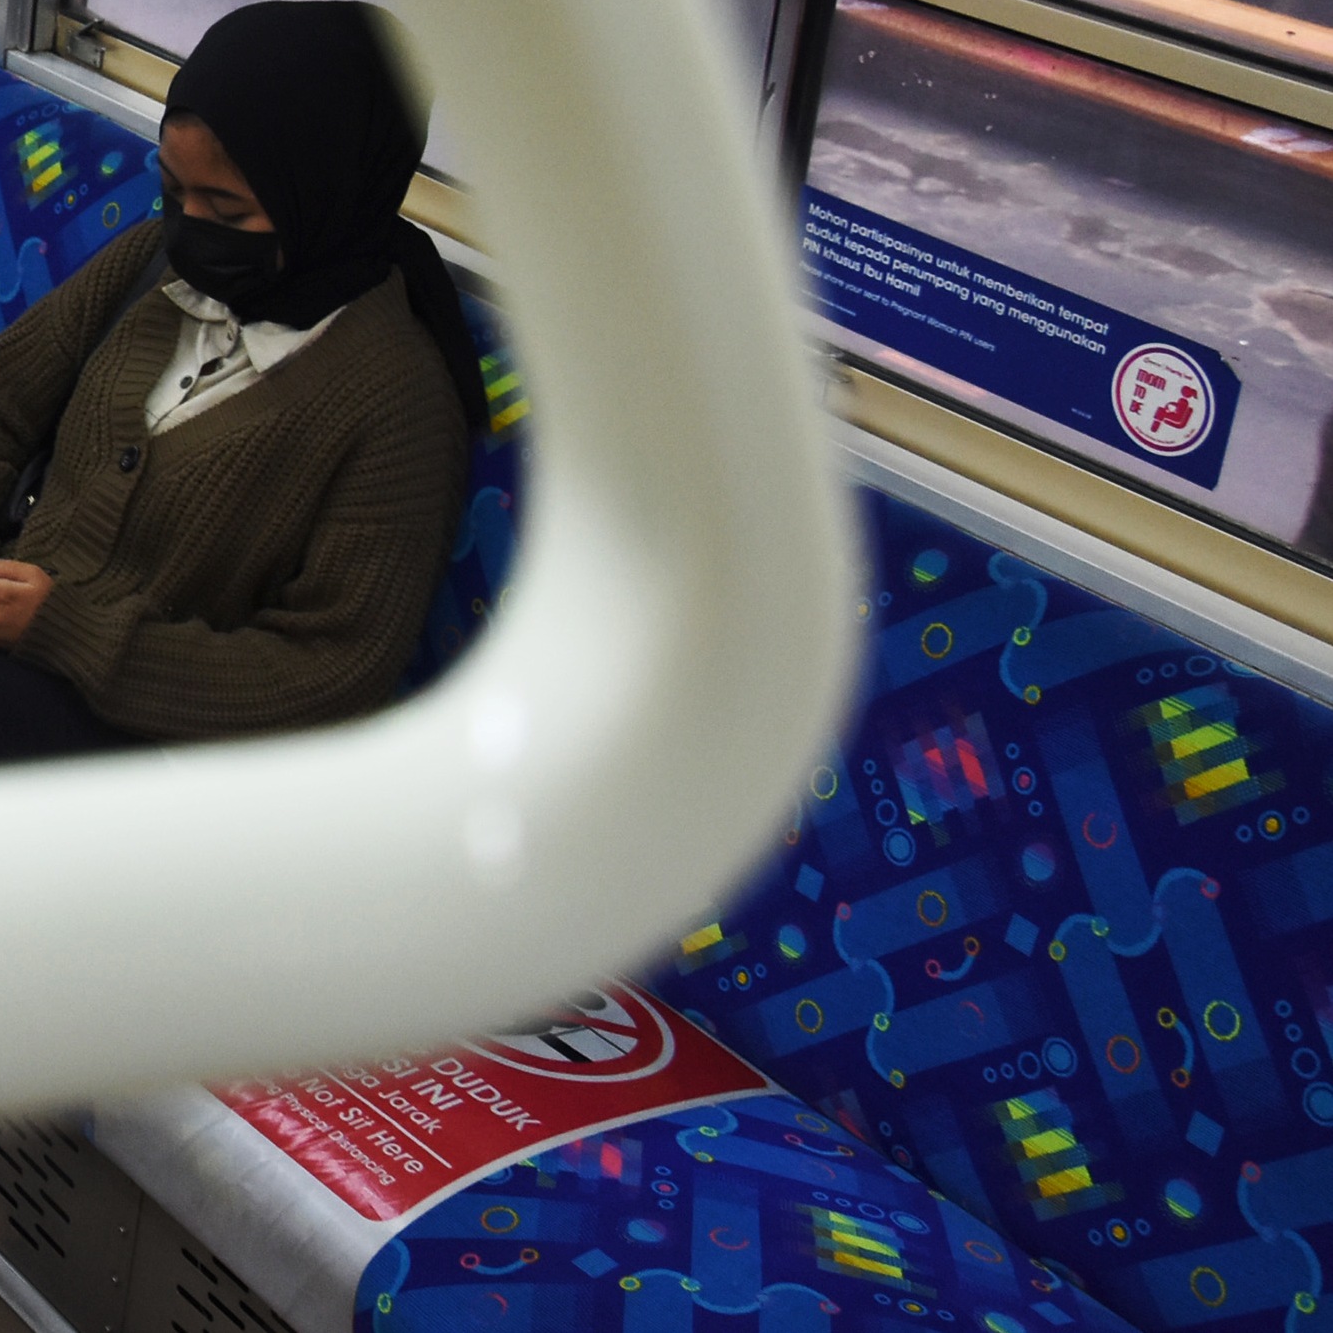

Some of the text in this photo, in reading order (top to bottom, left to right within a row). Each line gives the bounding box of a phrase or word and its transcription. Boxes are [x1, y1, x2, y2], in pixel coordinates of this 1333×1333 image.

[802, 237, 922, 298] PIN khusus Ibu Hamil
[805, 222, 1107, 356] duduk kepada penumpang yang menggunakan
[808, 202, 1110, 336] Mohon partisipasinya untuk memberikan tempat
[844, 281, 863, 295] your
[889, 300, 928, 324] Pregnant
[958, 329, 974, 343] PIN
[973, 337, 997, 353] users
[297, 1076, 346, 1109] Not
[338, 1106, 375, 1131] Sit
[366, 1129, 426, 1175] Here
[377, 1089, 444, 1136] Jarak
[409, 1077, 465, 1112] INI
[430, 1055, 542, 1133] DUDUK
[280, 1090, 397, 1187] Physical Distancing
